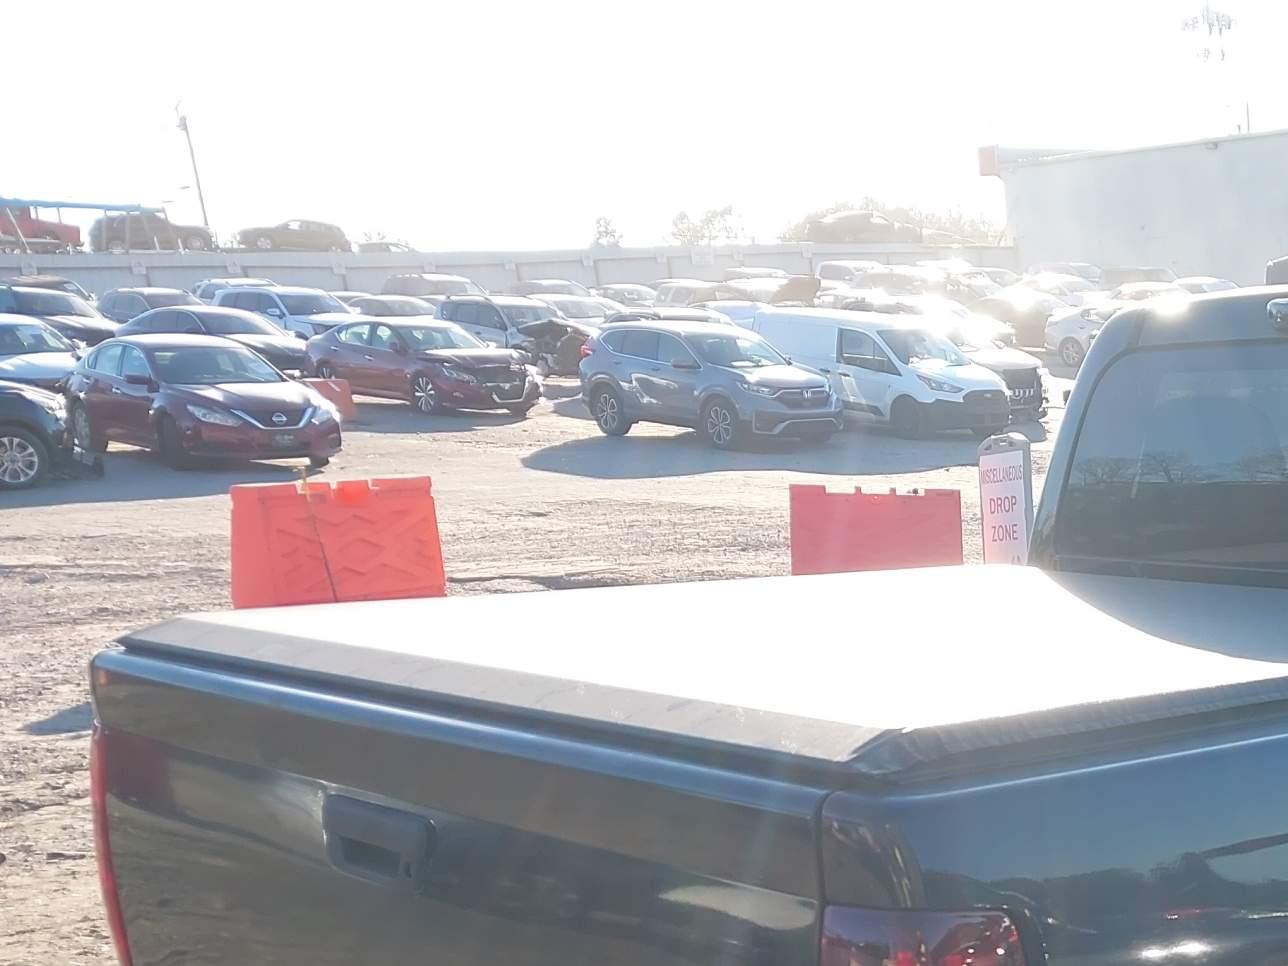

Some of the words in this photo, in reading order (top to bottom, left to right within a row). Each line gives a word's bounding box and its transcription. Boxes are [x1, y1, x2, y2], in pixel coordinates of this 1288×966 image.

[980, 465, 1022, 483] MISCELLANEOUS
[989, 496, 1017, 514] DROP
[991, 524, 1018, 542] ZONE
